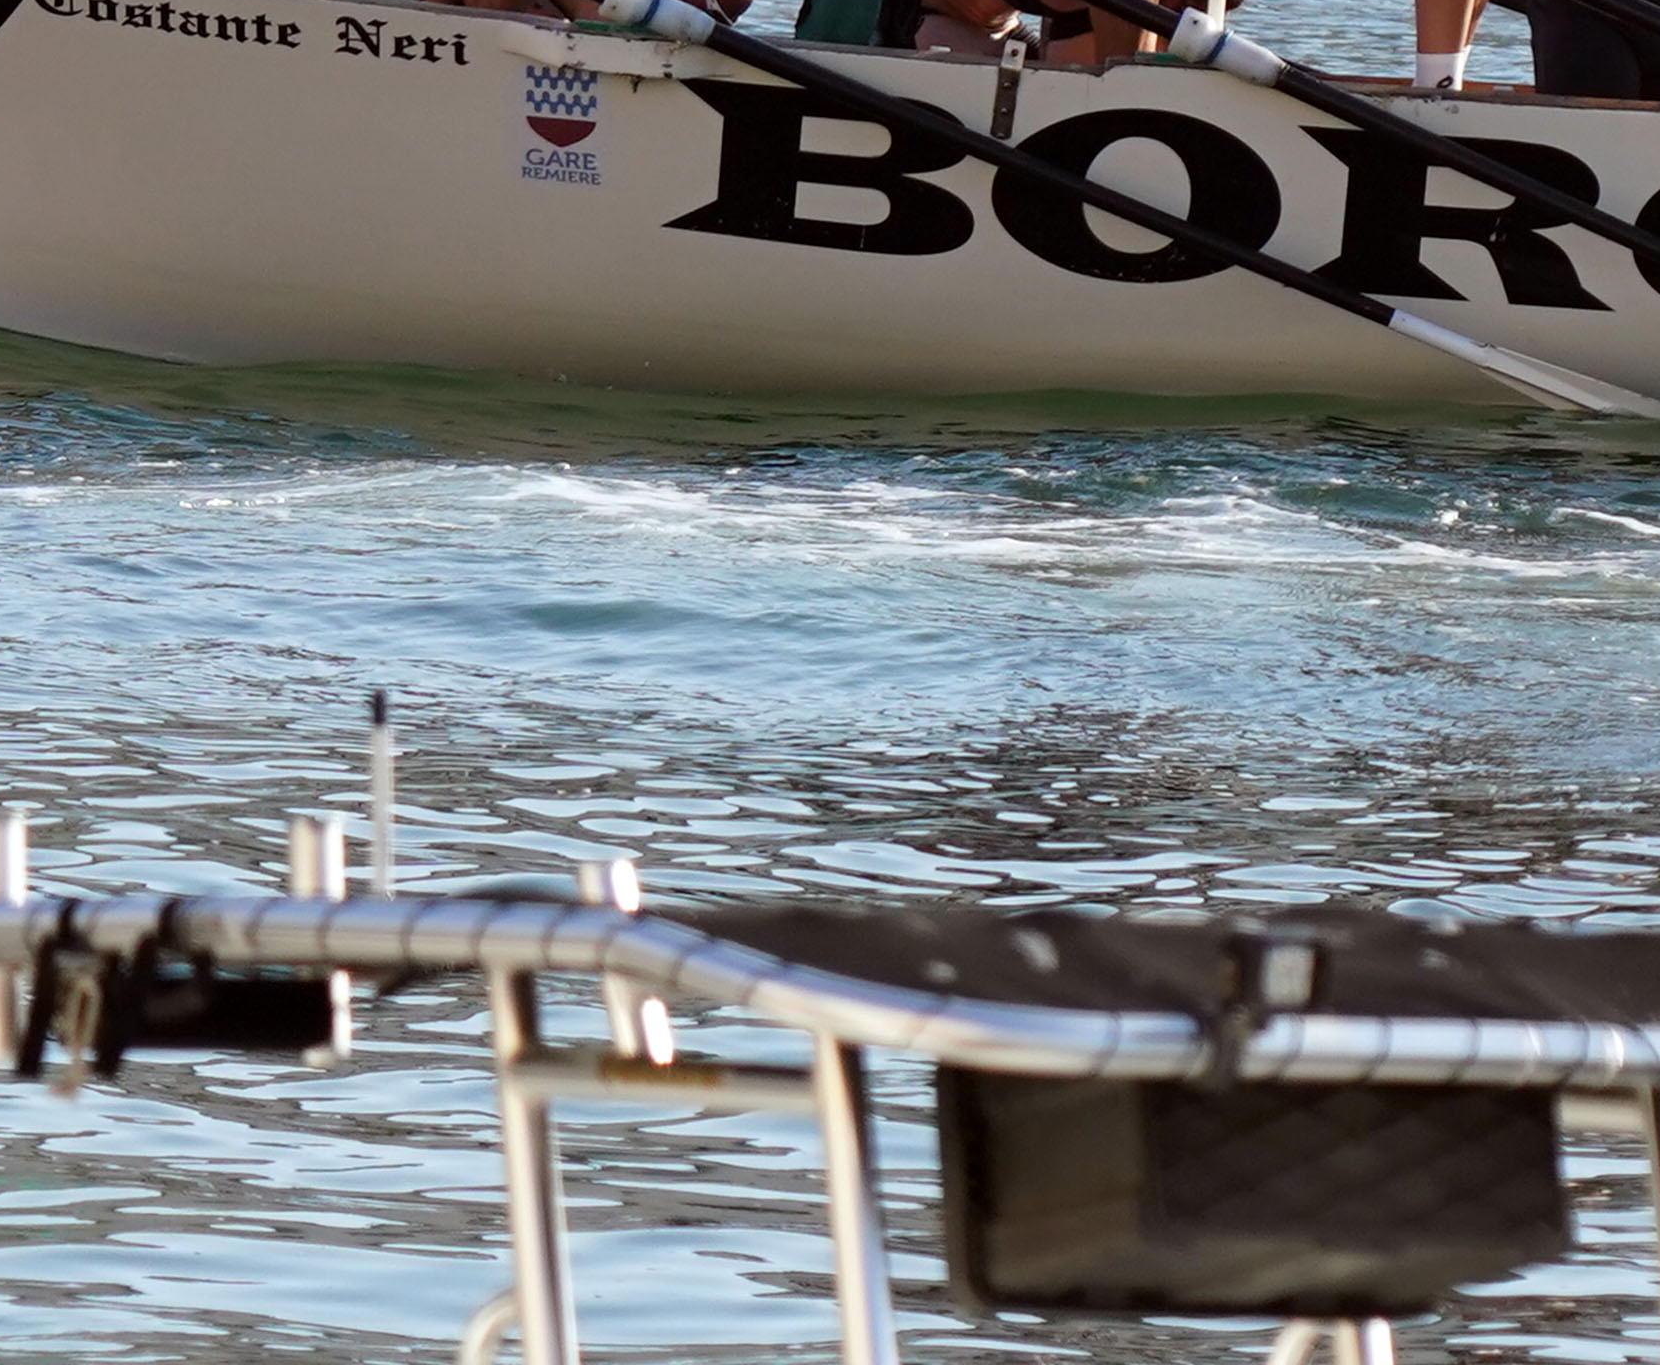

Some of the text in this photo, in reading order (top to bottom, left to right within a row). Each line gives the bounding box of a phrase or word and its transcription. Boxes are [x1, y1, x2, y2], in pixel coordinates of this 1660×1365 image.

[335, 15, 471, 67] Neri
[526, 148, 597, 171] GARE
[521, 166, 602, 186] REMIERE
